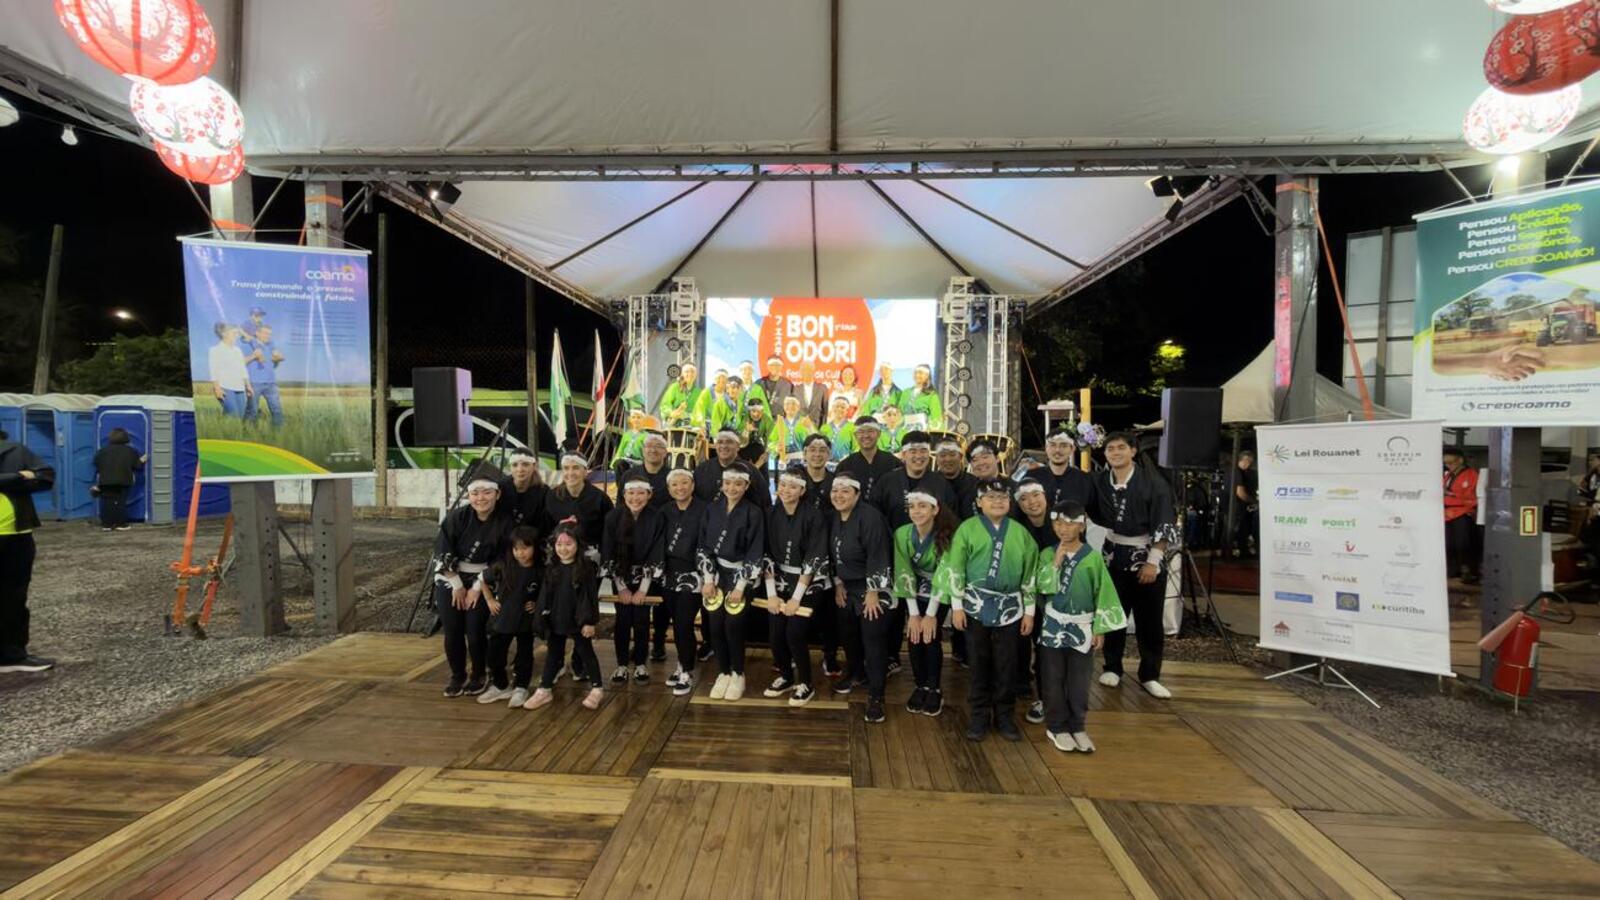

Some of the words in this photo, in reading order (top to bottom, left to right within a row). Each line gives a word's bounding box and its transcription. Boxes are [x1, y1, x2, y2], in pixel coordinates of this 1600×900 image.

[1459, 216, 1507, 231] Pensou
[1467, 225, 1516, 239] Pensou
[1468, 235, 1517, 249] Pensou
[1458, 247, 1506, 260] Pensou
[1447, 262, 1494, 275] Pensou
[1494, 247, 1595, 268] CREDICOAMO!
[305, 269, 356, 281] coamo
[786, 314, 834, 338] BON
[785, 340, 857, 364] ODORI
